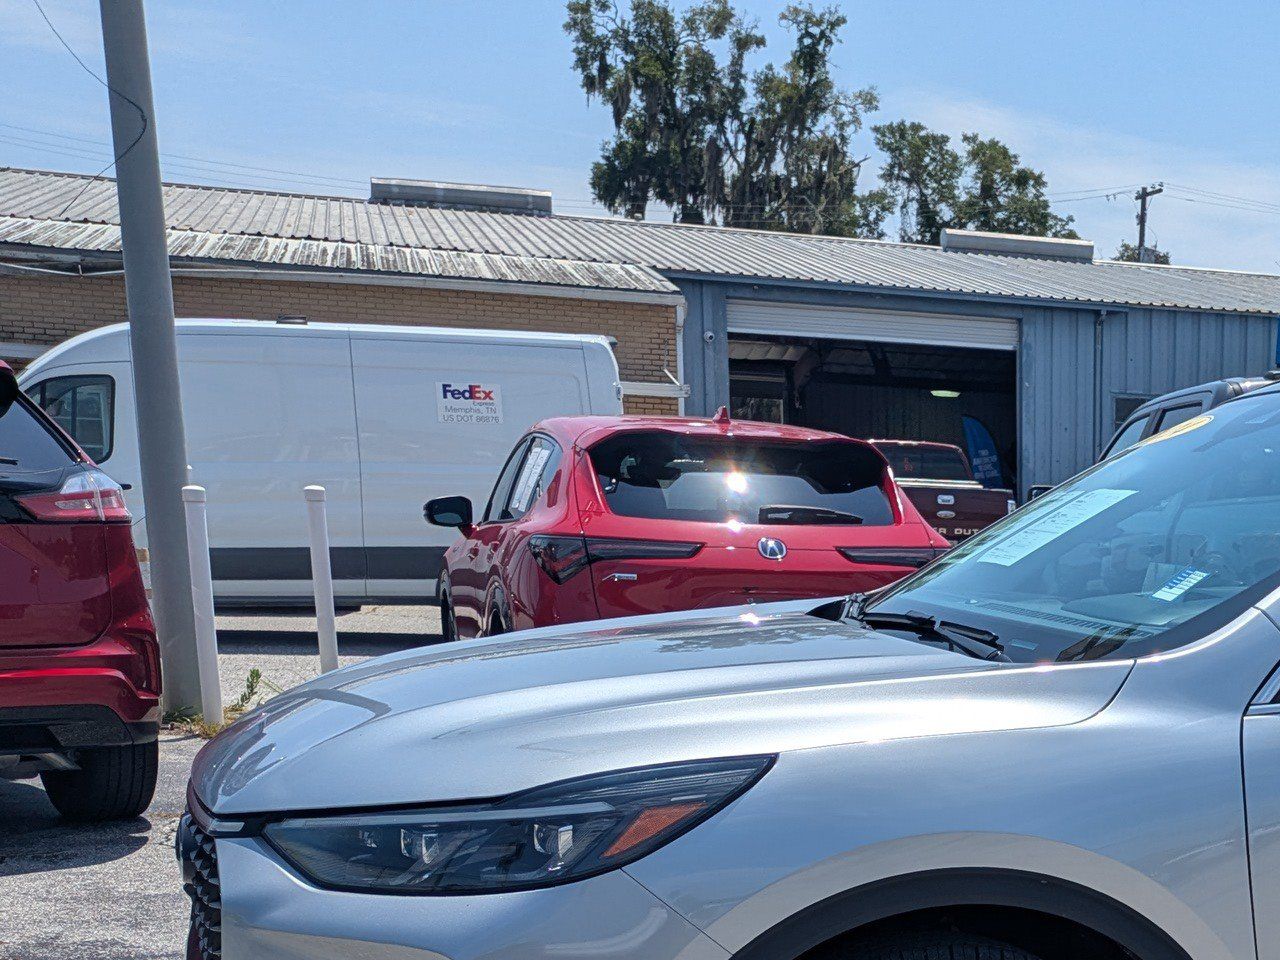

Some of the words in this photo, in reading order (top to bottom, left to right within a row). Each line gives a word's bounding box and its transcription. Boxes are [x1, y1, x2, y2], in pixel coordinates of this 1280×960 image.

[442, 383, 494, 401] FedEx
[443, 414, 454, 422] US
[456, 414, 473, 422] DOT
[954, 527, 980, 535] DUT
